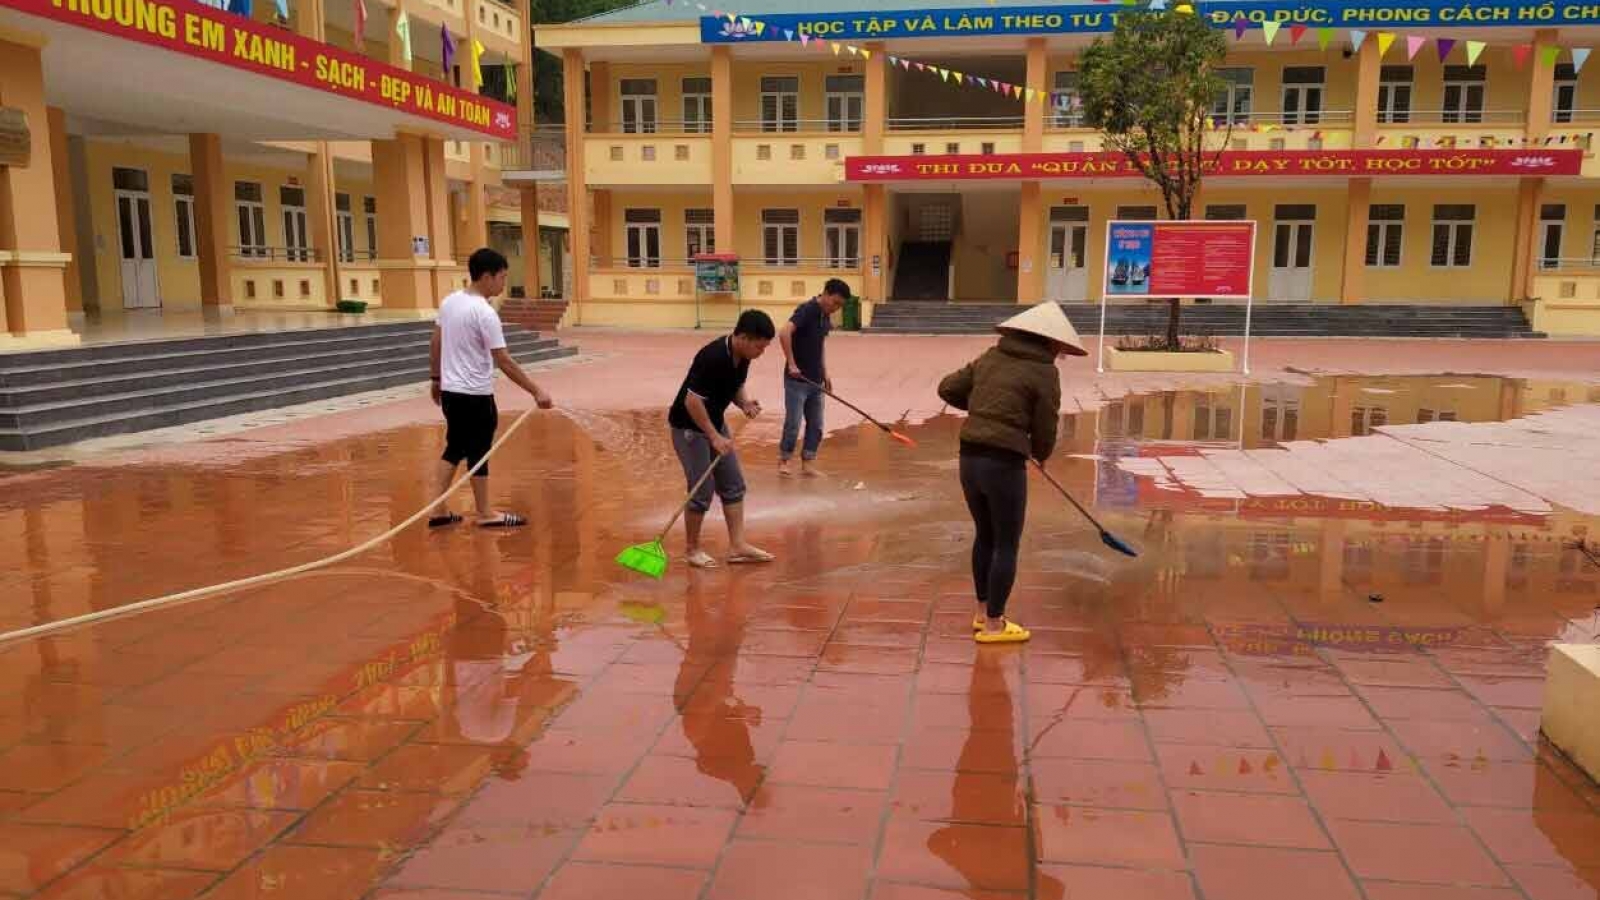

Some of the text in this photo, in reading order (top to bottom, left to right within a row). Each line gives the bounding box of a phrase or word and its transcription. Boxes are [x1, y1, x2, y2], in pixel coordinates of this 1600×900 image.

[852, 17, 897, 36] TẬP
[904, 15, 937, 31] VÀ
[944, 14, 994, 31] LÀM
[1000, 14, 1062, 29] THEO
[1342, 8, 1431, 23] PHONG
[1438, 4, 1510, 21] CÁCH
[184, 12, 226, 52] EM
[233, 27, 295, 72] XANH
[316, 53, 365, 92] SẠCH
[381, 73, 411, 106] ĐẸP
[414, 83, 433, 112] VÀ
[437, 92, 457, 117] AN
[917, 163, 960, 175] THI
[1366, 157, 1421, 172] HỌC
